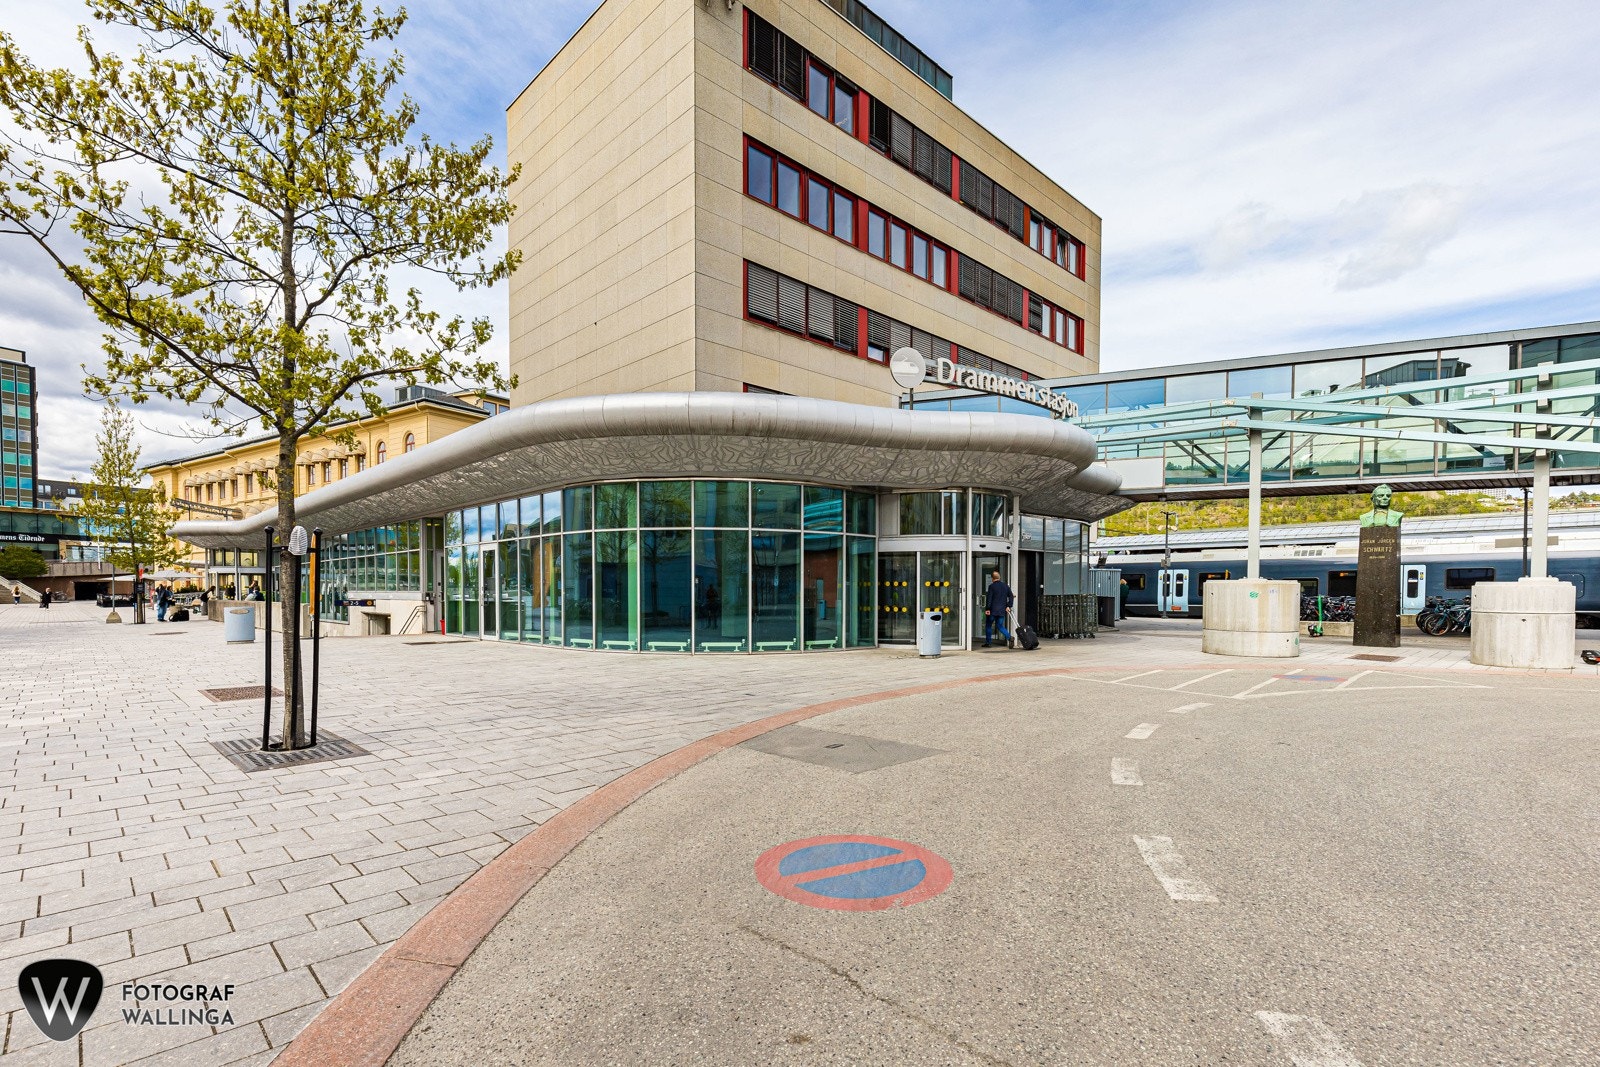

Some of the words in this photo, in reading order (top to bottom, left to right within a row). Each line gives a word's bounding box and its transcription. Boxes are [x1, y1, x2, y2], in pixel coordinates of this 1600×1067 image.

[937, 357, 1036, 404] Drammen
[1038, 387, 1079, 420] stasjon
[18, 533, 45, 542] Tidende
